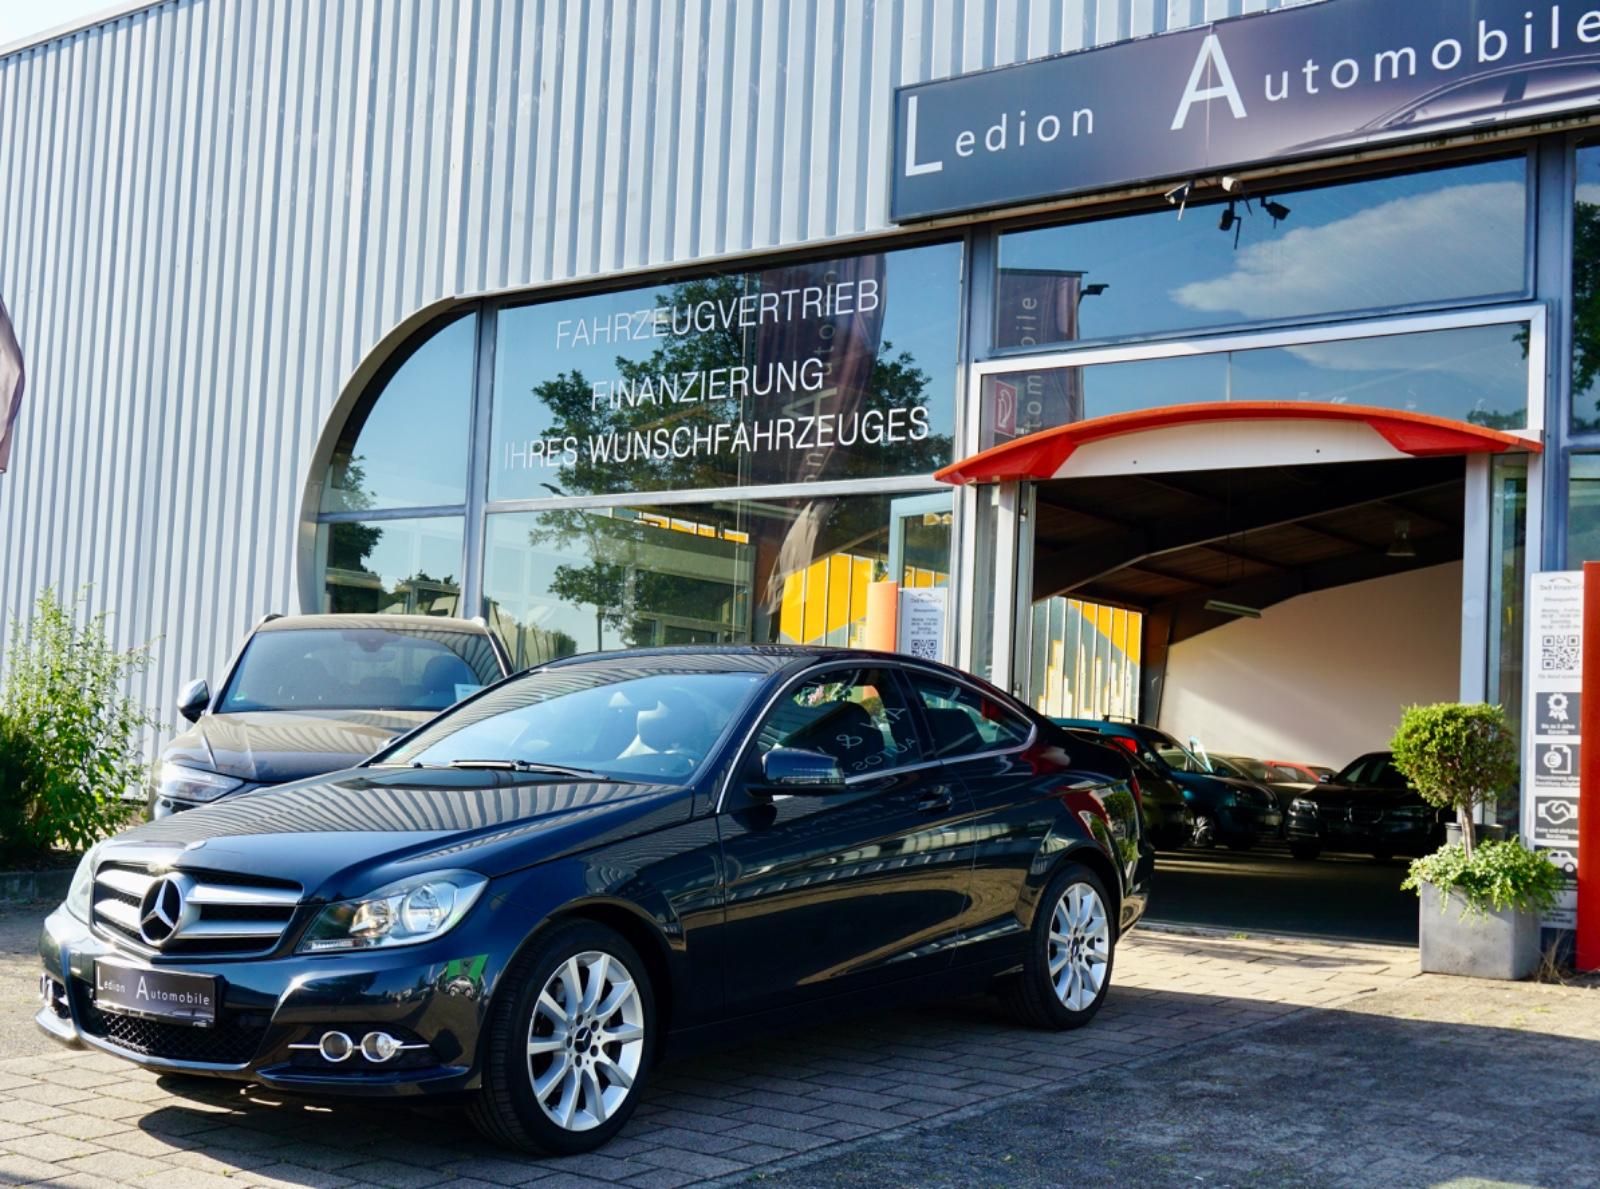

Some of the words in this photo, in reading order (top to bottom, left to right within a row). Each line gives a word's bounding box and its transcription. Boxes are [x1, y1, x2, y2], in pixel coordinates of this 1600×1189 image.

[905, 95, 1094, 176] Ledion
[1170, 5, 1600, 131] Automobile
[556, 279, 879, 350] FAHRZEUGVERTRIEB
[591, 357, 824, 411] FINANZIERUNG
[504, 435, 579, 470] IHRES
[588, 405, 930, 464] WUNSCHFAHRZEUGES
[96, 965, 126, 993] Ledion
[136, 974, 210, 1006] Automobile
